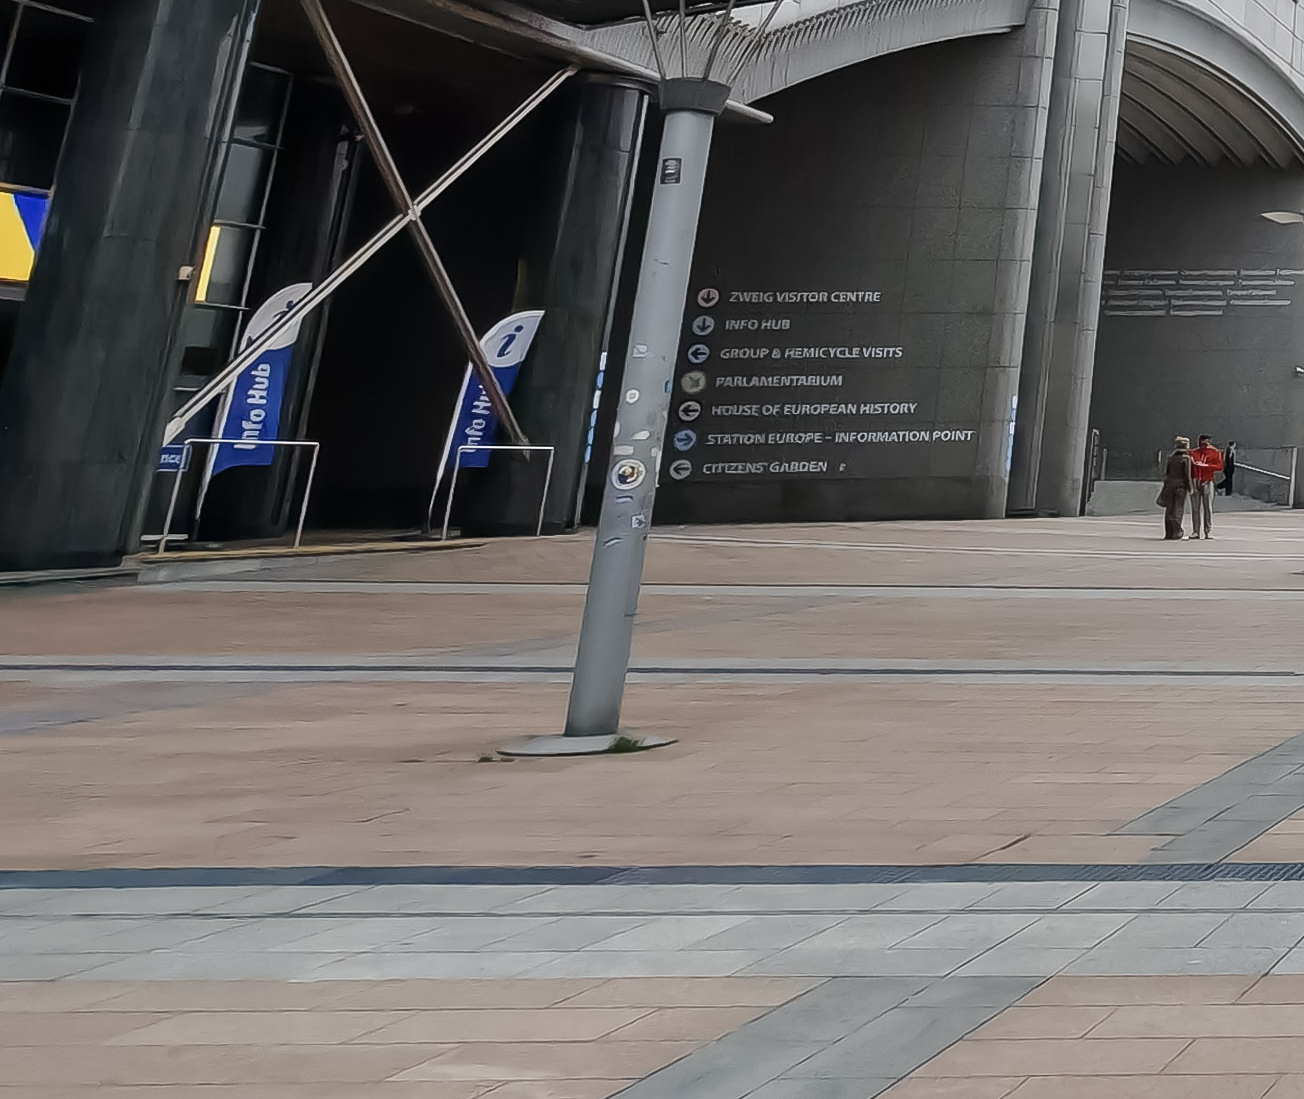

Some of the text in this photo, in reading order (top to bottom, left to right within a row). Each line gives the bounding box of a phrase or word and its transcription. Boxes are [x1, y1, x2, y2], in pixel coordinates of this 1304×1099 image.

[729, 291, 882, 303] ZWEIG VISITOR CENTRE
[725, 318, 791, 331] INFO HUB
[720, 348, 769, 360] GROUP
[785, 347, 860, 359] HEMICYCLE
[862, 346, 903, 358] VISITS
[715, 375, 843, 388] PARLAMENTARIUM
[234, 363, 271, 450] Info Hub
[711, 402, 918, 416] HOUSE OF EUROPEAN HISTORY
[460, 418, 486, 453] Info
[705, 434, 766, 445] STATION
[767, 432, 823, 444] EUROPE
[834, 431, 931, 443] INFORMATION
[932, 430, 975, 442] POINT
[769, 461, 828, 473] GARDEN
